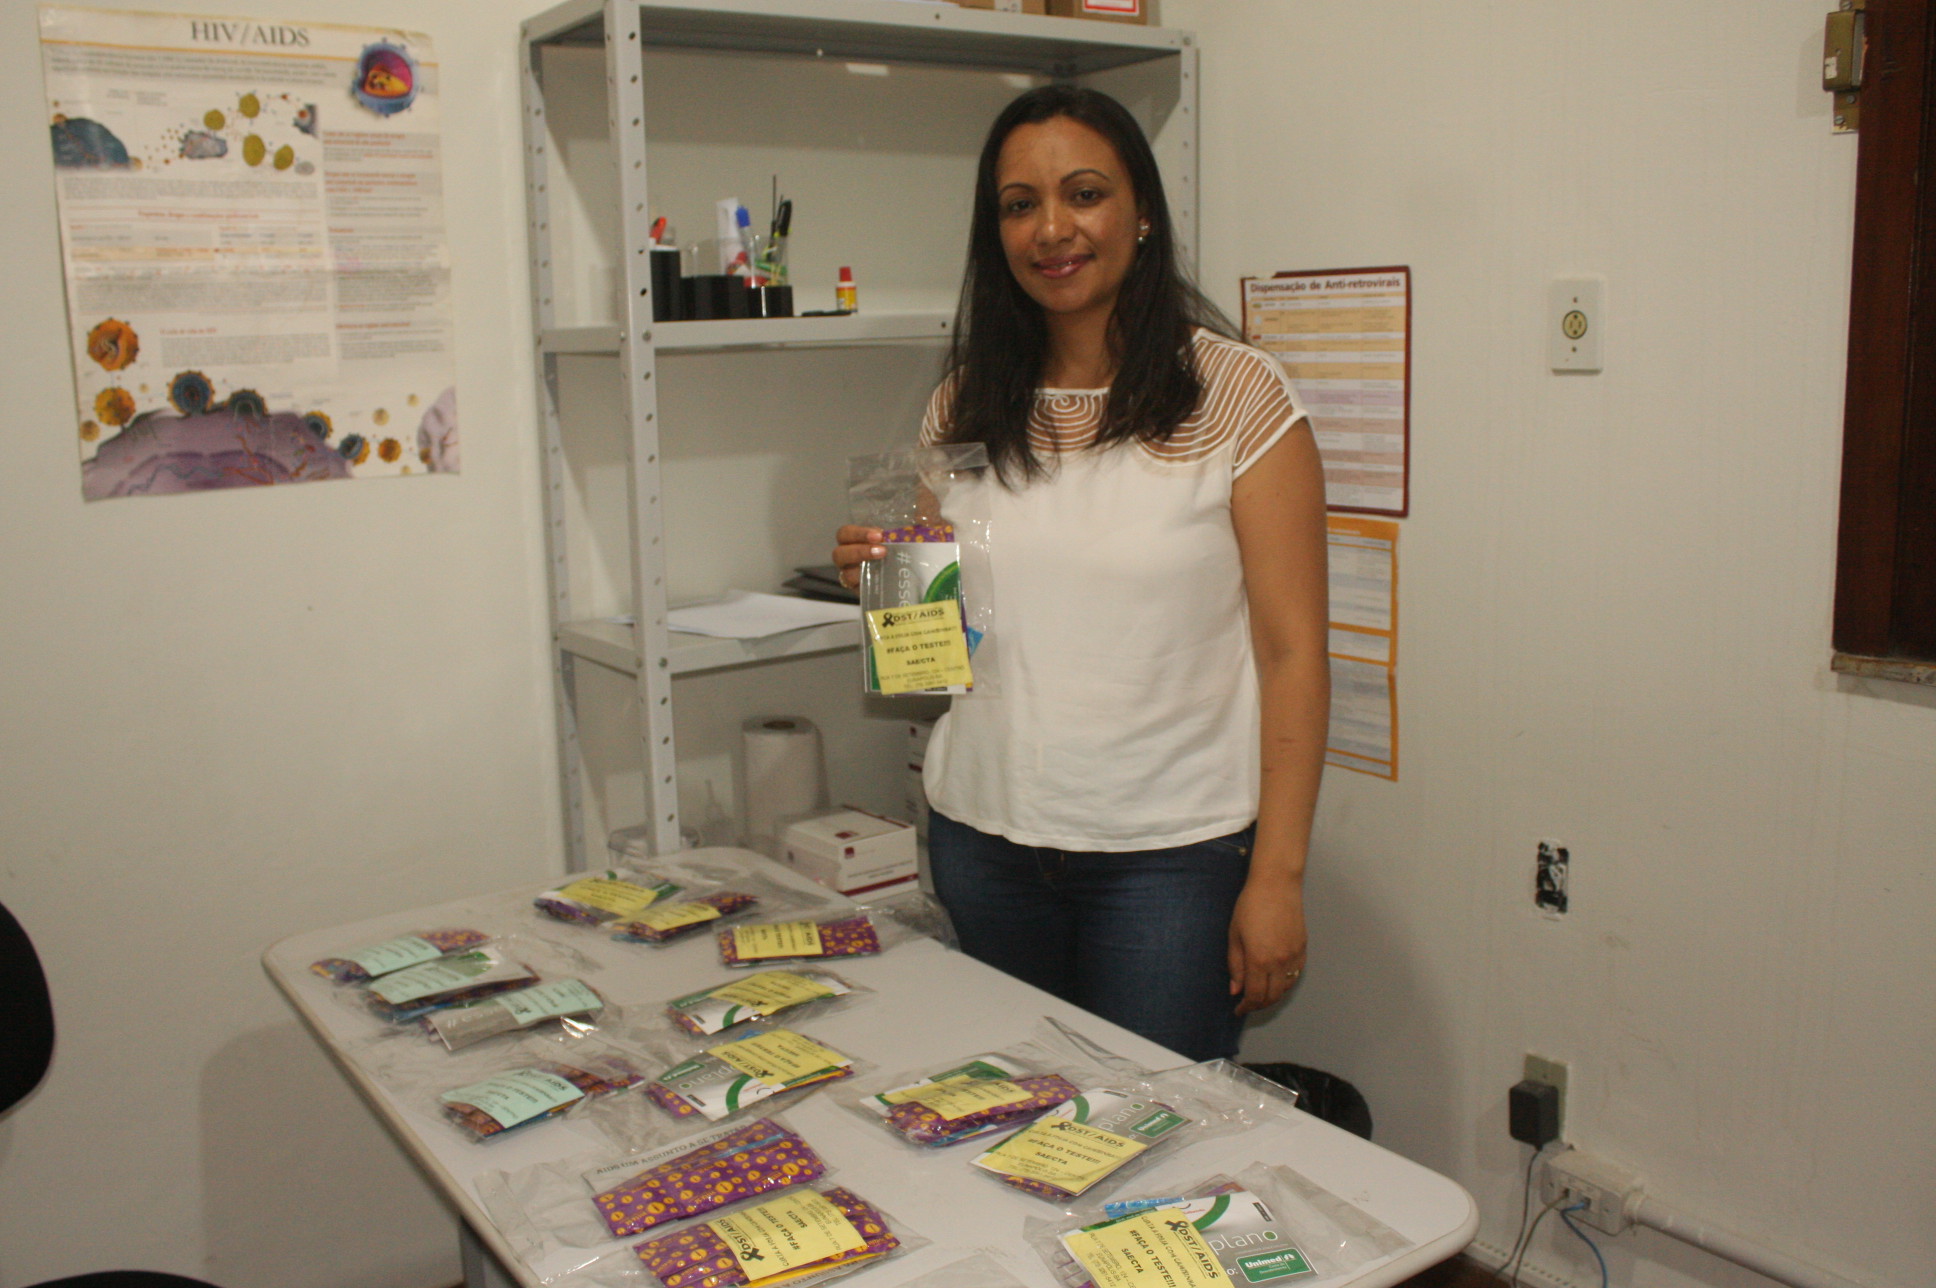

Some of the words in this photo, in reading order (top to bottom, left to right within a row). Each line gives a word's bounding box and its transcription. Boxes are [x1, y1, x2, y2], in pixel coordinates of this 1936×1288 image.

[191, 21, 311, 47] HIV/AIDS
[1251, 281, 1306, 293] Dispensação
[1310, 280, 1321, 290] de
[1325, 277, 1400, 290] Anti-retrovirais
[893, 607, 945, 622] DST/AIDS
[1098, 1103, 1145, 1132] plano
[1066, 1125, 1127, 1147] DST/AIDS
[596, 1162, 619, 1176] AIDS
[641, 1145, 688, 1166] ASSUNTO
[717, 1218, 752, 1251] DST/AIDS
[783, 1228, 801, 1250] #FAÇA
[1208, 1230, 1278, 1256] plano
[1128, 1229, 1150, 1249] #FAÇA
[1149, 1255, 1177, 1288] TESTE!!!
[1177, 1227, 1219, 1279] DST/AIDS
[1244, 1256, 1282, 1268] Unimed
